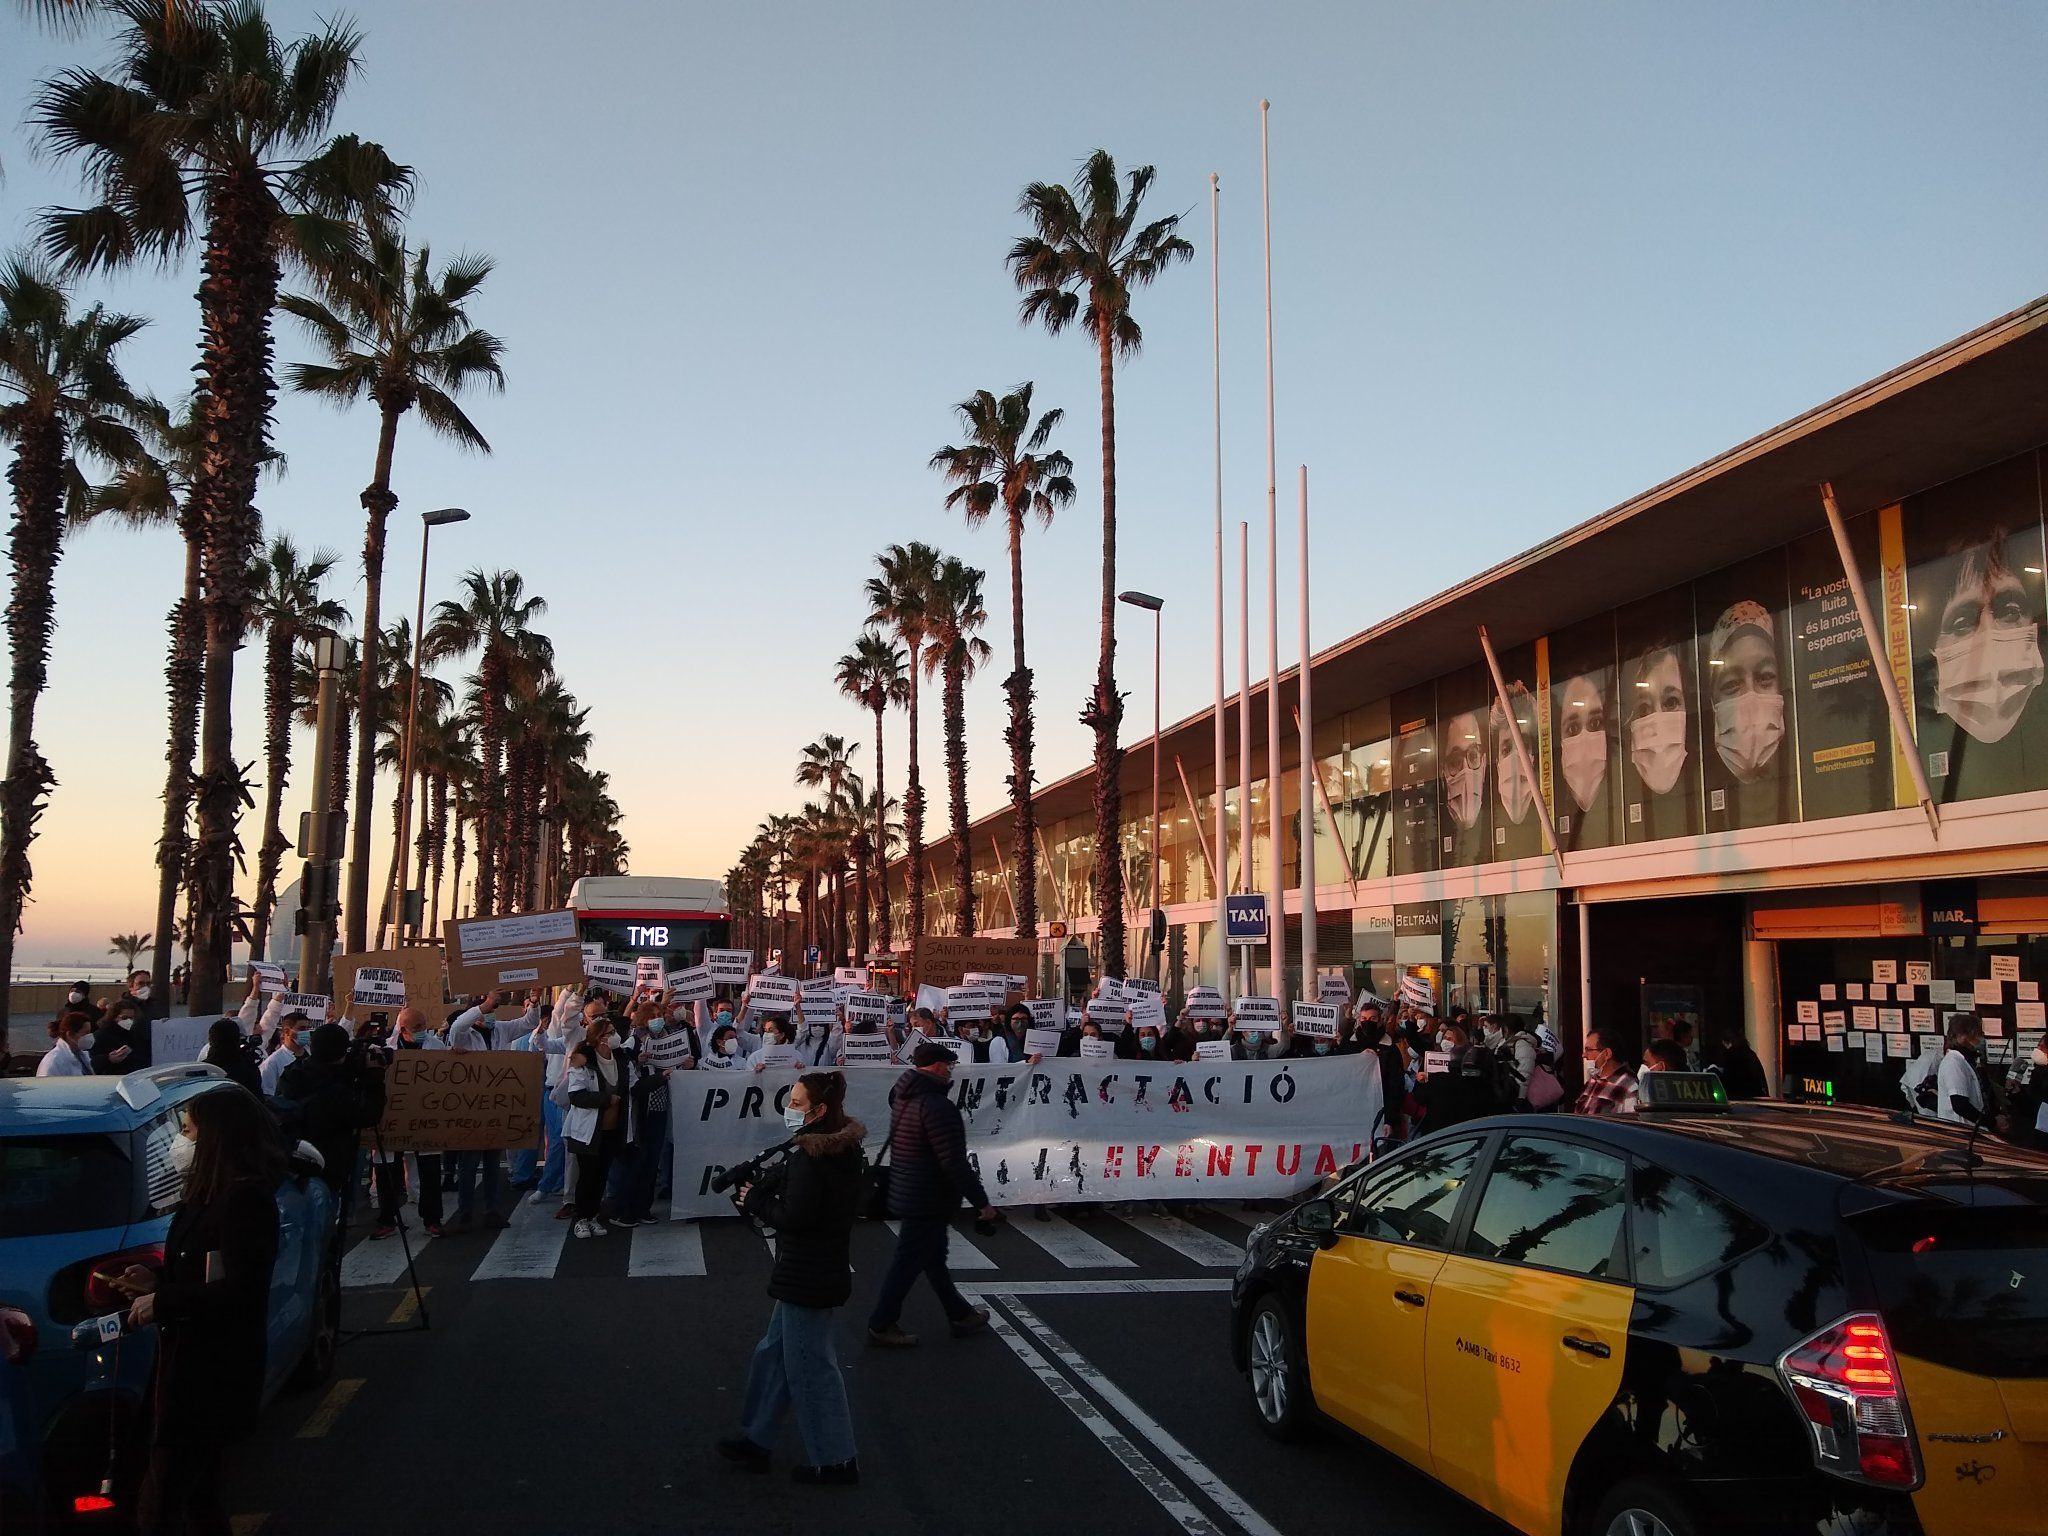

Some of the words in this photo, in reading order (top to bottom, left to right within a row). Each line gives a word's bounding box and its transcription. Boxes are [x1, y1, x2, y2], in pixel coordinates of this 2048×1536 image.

[1824, 579, 1852, 595] vostr
[1888, 563, 1902, 624] MASK
[1822, 595, 1847, 612] lluita
[1806, 619, 1818, 634] és
[1820, 617, 1829, 630] la
[1832, 610, 1861, 627] nostr
[1808, 626, 1867, 652] esperança.
[1892, 628, 1906, 670] THE
[1540, 679, 1549, 722] MASK
[1541, 726, 1550, 756] THE
[1228, 908, 1264, 923] TAXI
[1396, 910, 1439, 927] BELTRÁN
[1896, 913, 1917, 924] Salut
[627, 926, 669, 947] TMB
[773, 949, 782, 958] P
[811, 947, 818, 956] P
[923, 942, 978, 957] SANITAT
[359, 969, 379, 981] PROUS
[1910, 968, 1927, 981] 5%
[1125, 979, 1140, 990] PROUS
[283, 993, 299, 1006] ROUS
[848, 995, 871, 1008] NUESTRA
[1032, 1002, 1056, 1011] SANITAT
[856, 1011, 862, 1022] SE
[1036, 1010, 1053, 1021] 100%
[1296, 1005, 1318, 1018] NUESTRA
[1319, 1008, 1335, 1019] SALUD
[1296, 1021, 1303, 1031] NO
[1304, 1022, 1311, 1032] SE
[1311, 1023, 1333, 1035] NEGOCIA
[394, 1059, 525, 1089] ERGONYA
[700, 1083, 795, 1122] PRO
[952, 1066, 1297, 1110] NTRACTACIÓ
[1674, 1079, 1709, 1100] TAXI
[1803, 1078, 1826, 1095] TAXI
[389, 1093, 406, 1111] E
[422, 1091, 527, 1112] GOVERN
[380, 1118, 399, 1133] UE
[409, 1117, 440, 1132] ENS
[1464, 1341, 1480, 1357] AMB
[1483, 1346, 1498, 1365] Taxi
[1500, 1354, 1521, 1374] 8632
